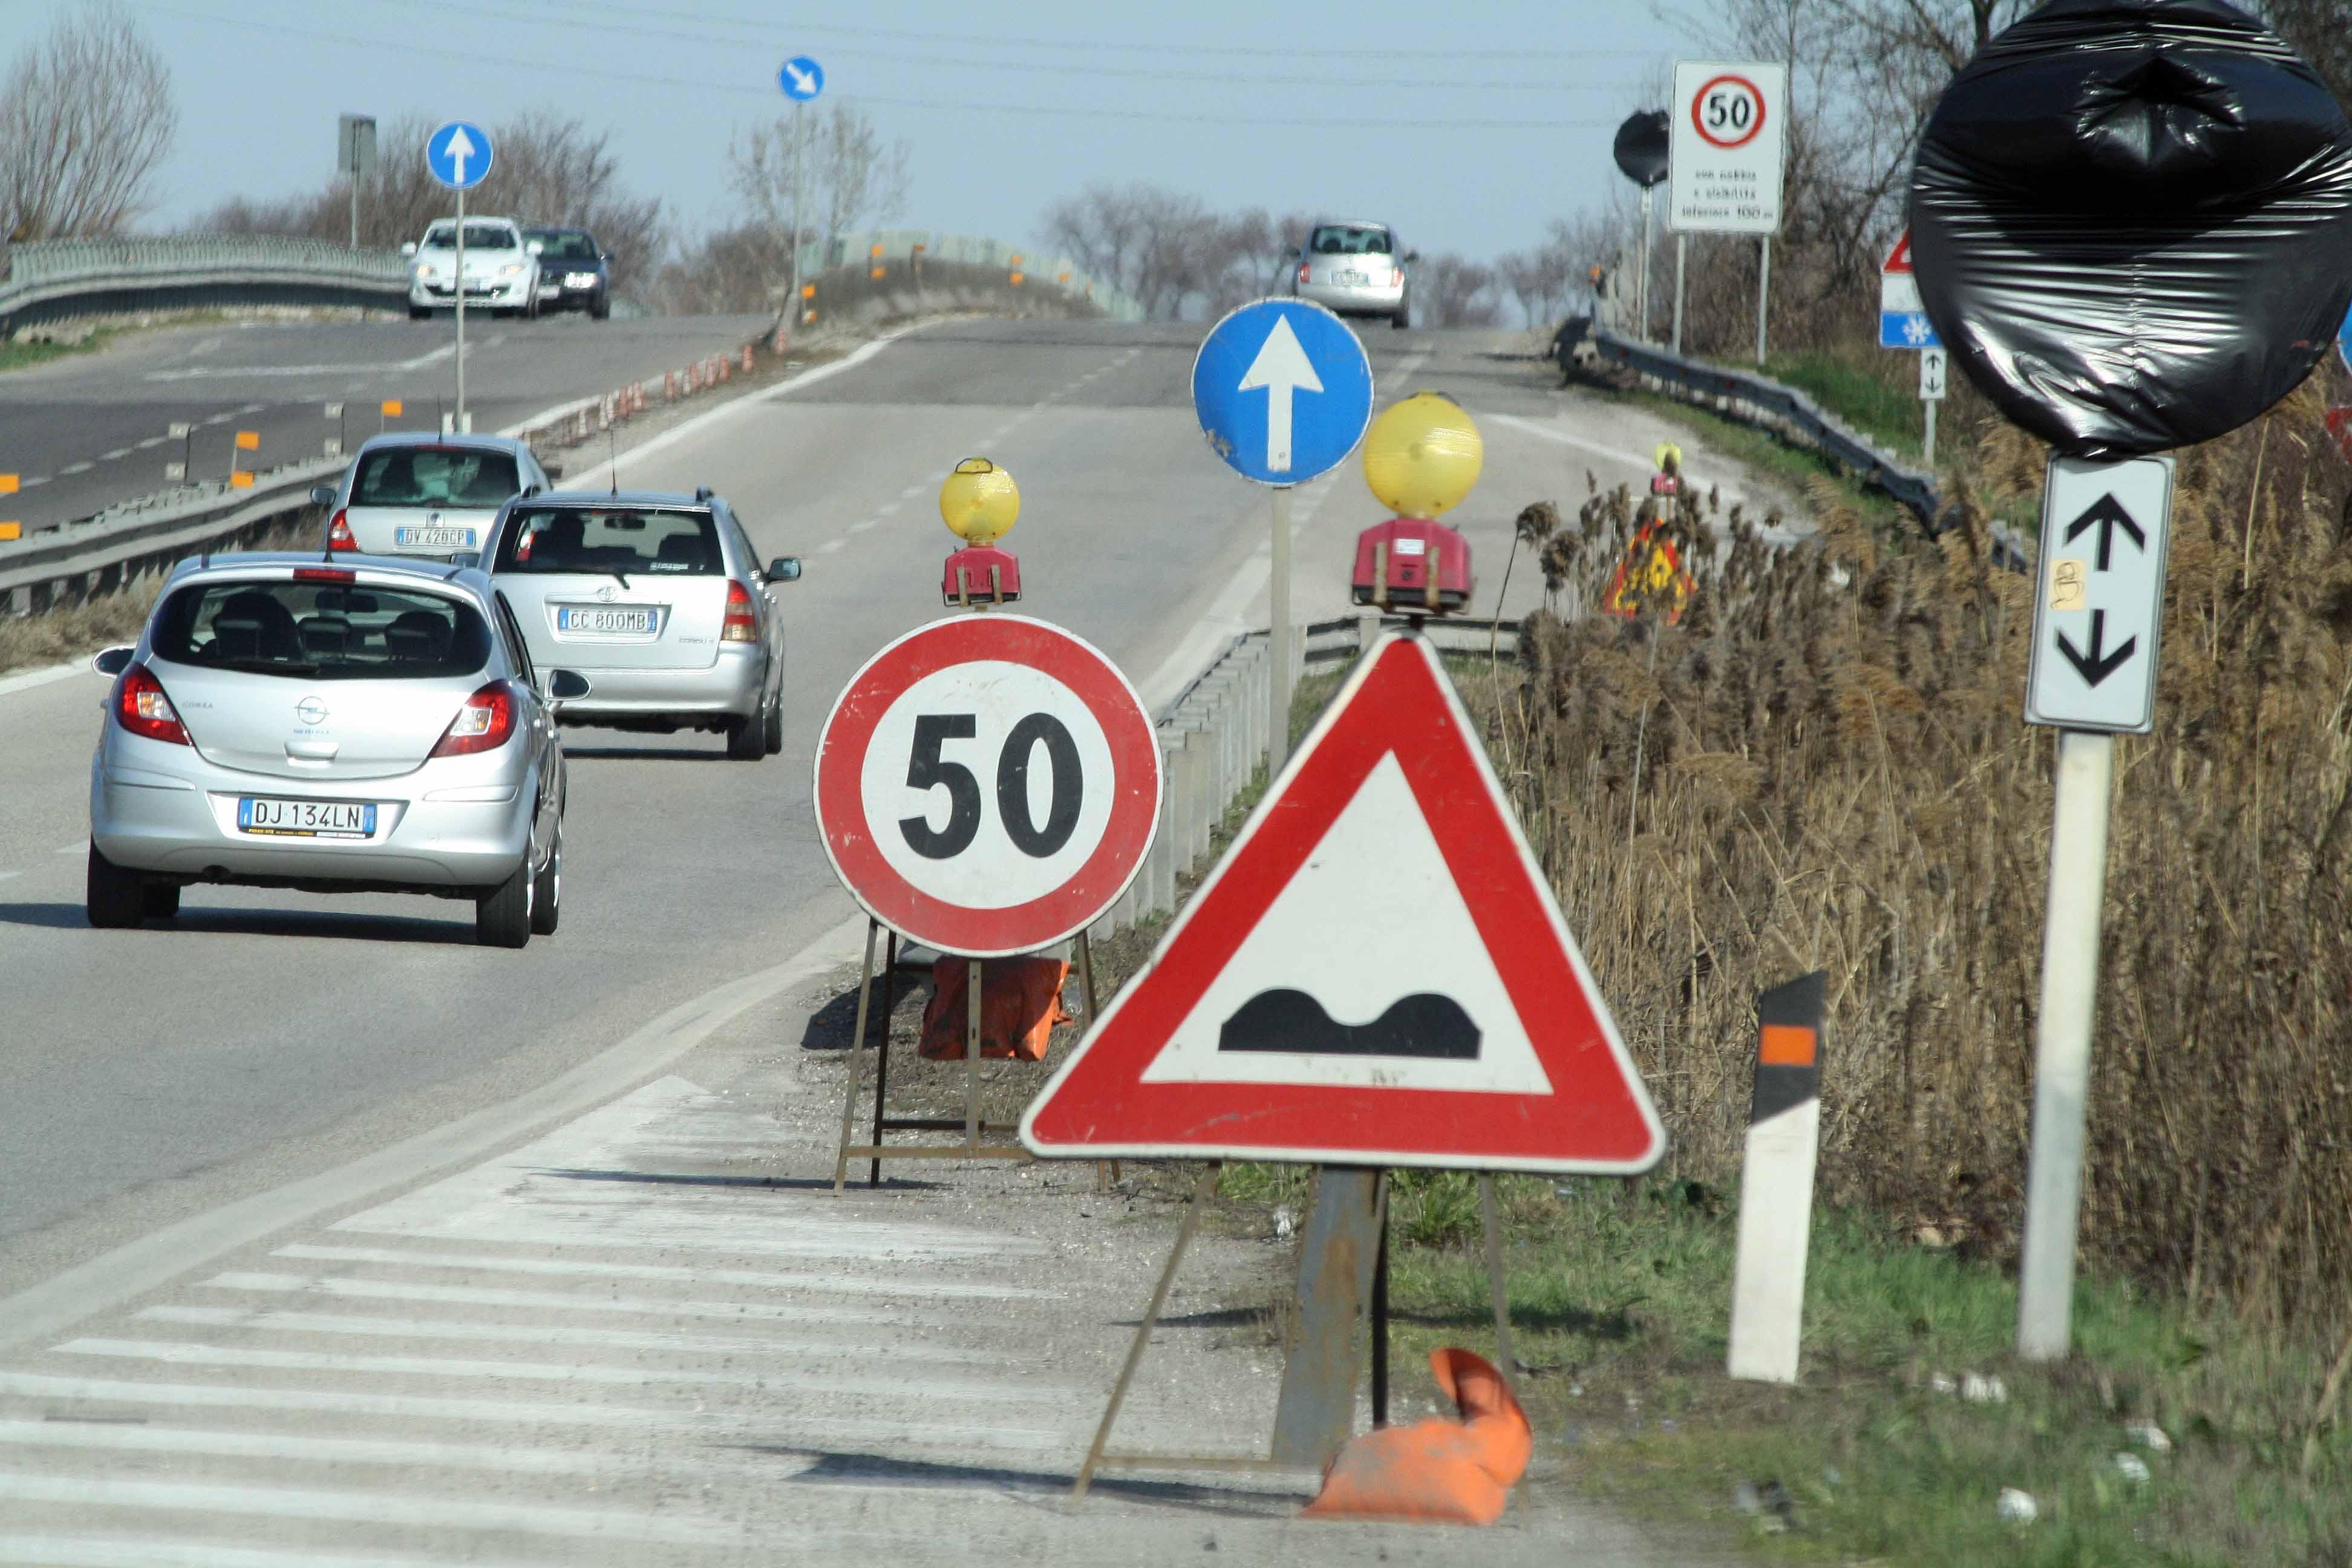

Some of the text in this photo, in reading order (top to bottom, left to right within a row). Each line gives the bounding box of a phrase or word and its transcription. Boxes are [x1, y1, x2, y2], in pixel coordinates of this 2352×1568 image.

[1709, 94, 1749, 128] 50
[570, 612, 589, 628] CC
[898, 712, 1083, 859] 50
[255, 802, 359, 828] DJ 134LN
